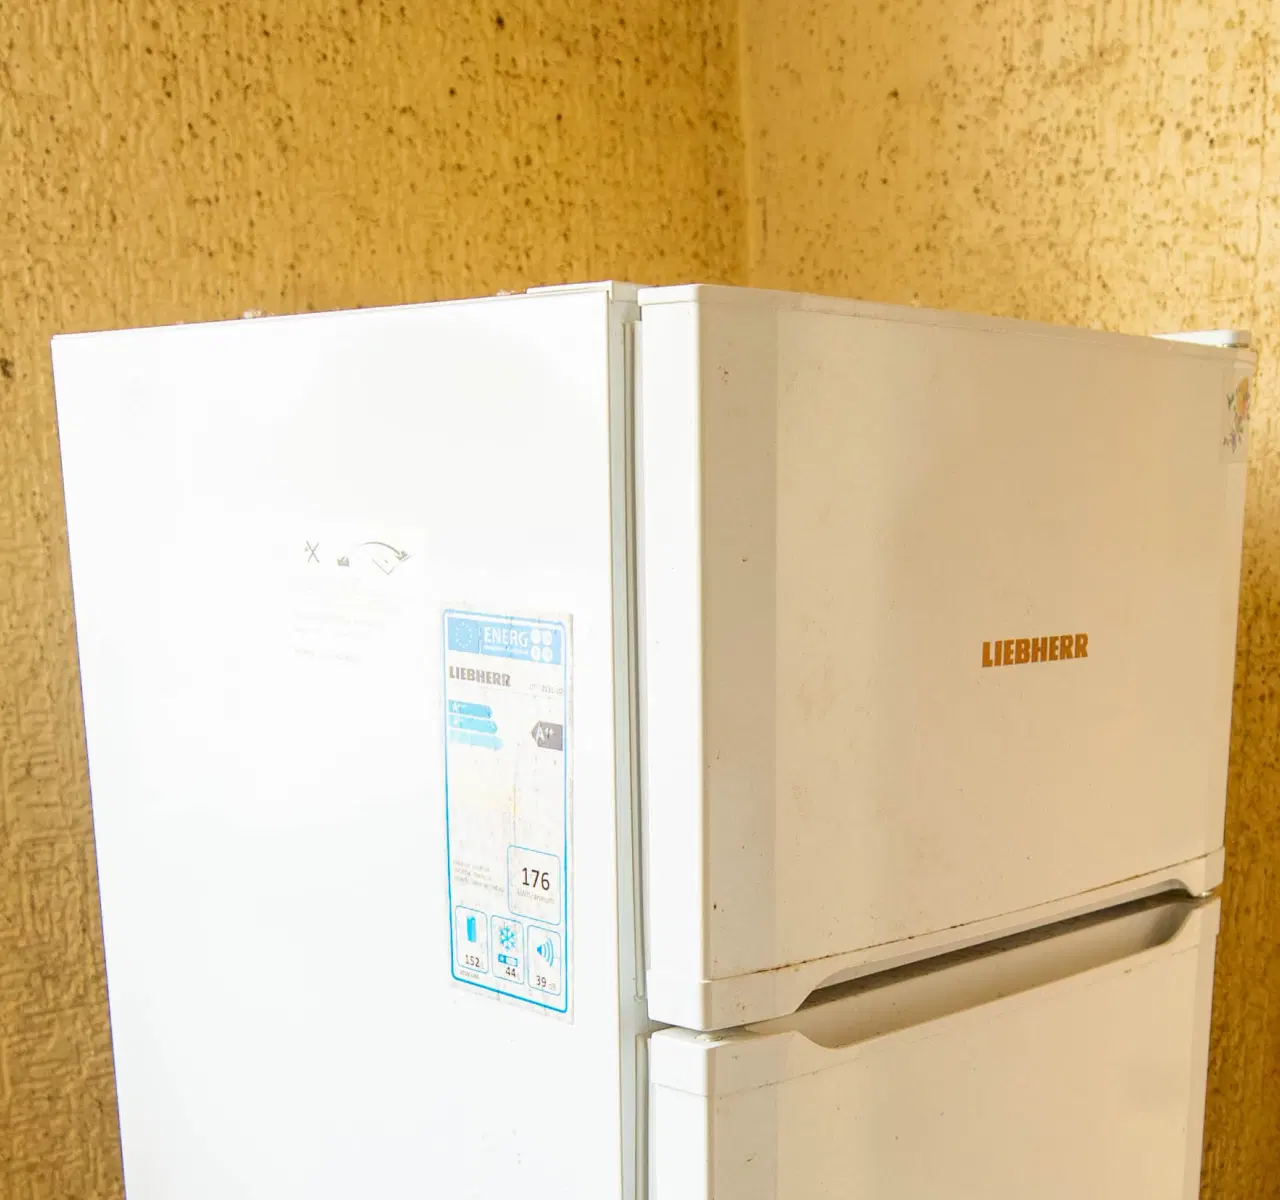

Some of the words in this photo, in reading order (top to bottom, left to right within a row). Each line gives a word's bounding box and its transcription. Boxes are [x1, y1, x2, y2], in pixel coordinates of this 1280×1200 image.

[484, 627, 528, 648] ENERG
[982, 633, 1088, 667] LIEBHERR
[449, 665, 511, 687] LIEBHERR
[522, 867, 550, 890] 176
[465, 954, 480, 968] 152
[505, 966, 516, 978] 44
[536, 975, 547, 987] 39
